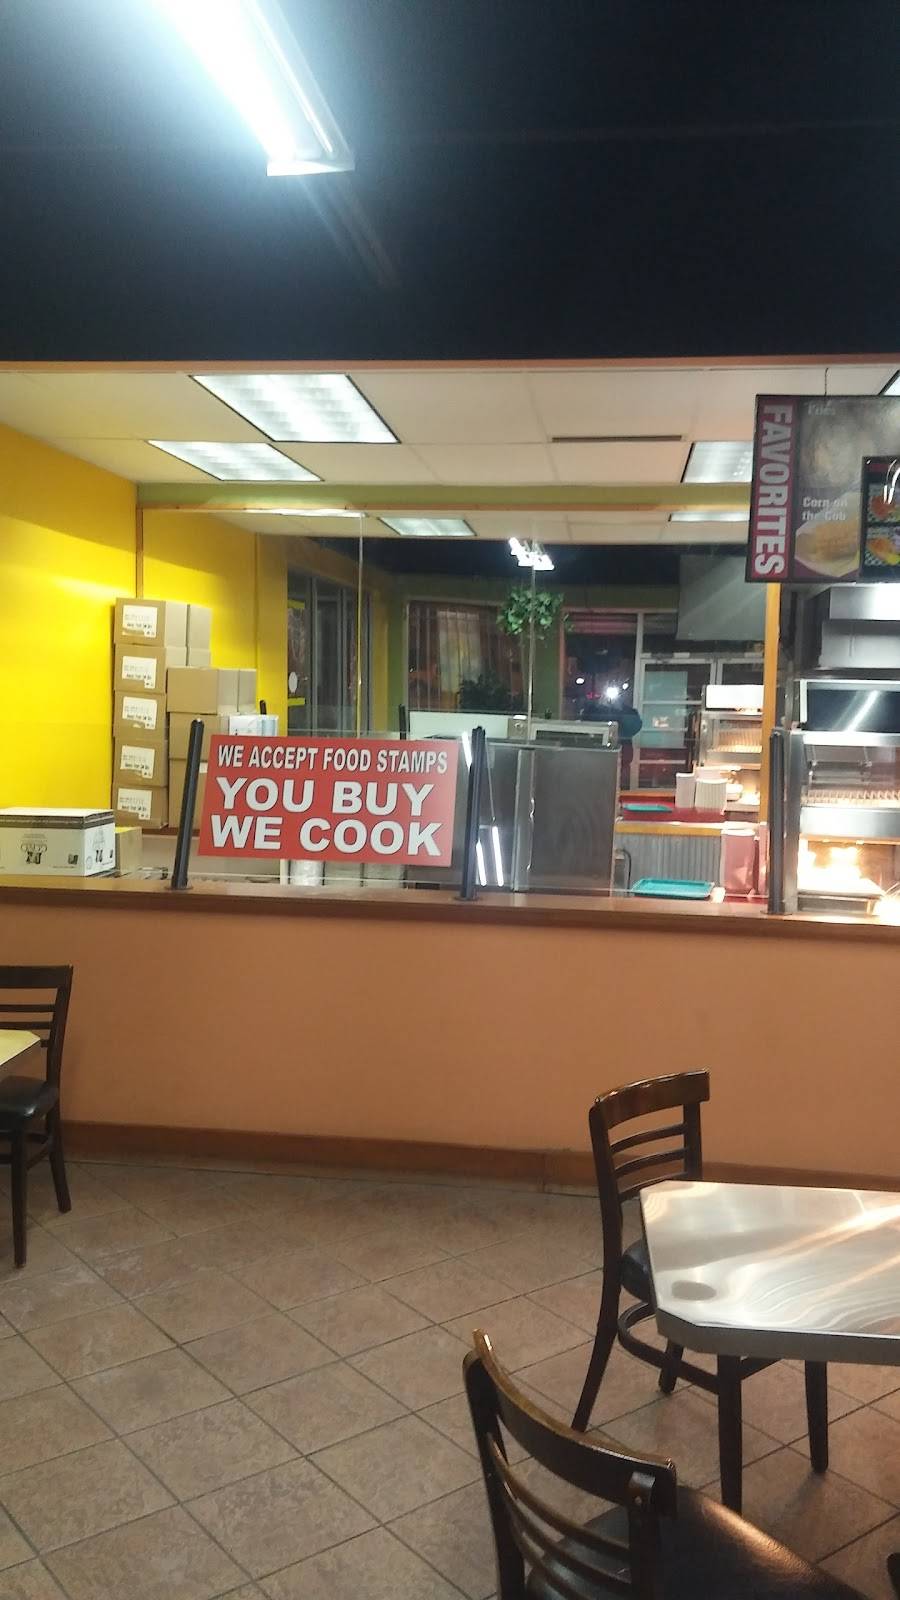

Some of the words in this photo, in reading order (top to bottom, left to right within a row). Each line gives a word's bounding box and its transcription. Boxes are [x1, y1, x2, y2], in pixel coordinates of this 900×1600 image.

[754, 404, 793, 575] FAVORITES
[802, 496, 829, 508] Corn
[218, 745, 244, 768] WE
[248, 745, 319, 770] ACCEPT
[323, 748, 372, 772] FOOD
[376, 749, 448, 774] STAMPS
[215, 776, 315, 813] YOU
[332, 780, 435, 817] BUY
[210, 814, 283, 850] WE
[299, 817, 443, 857] COOK
